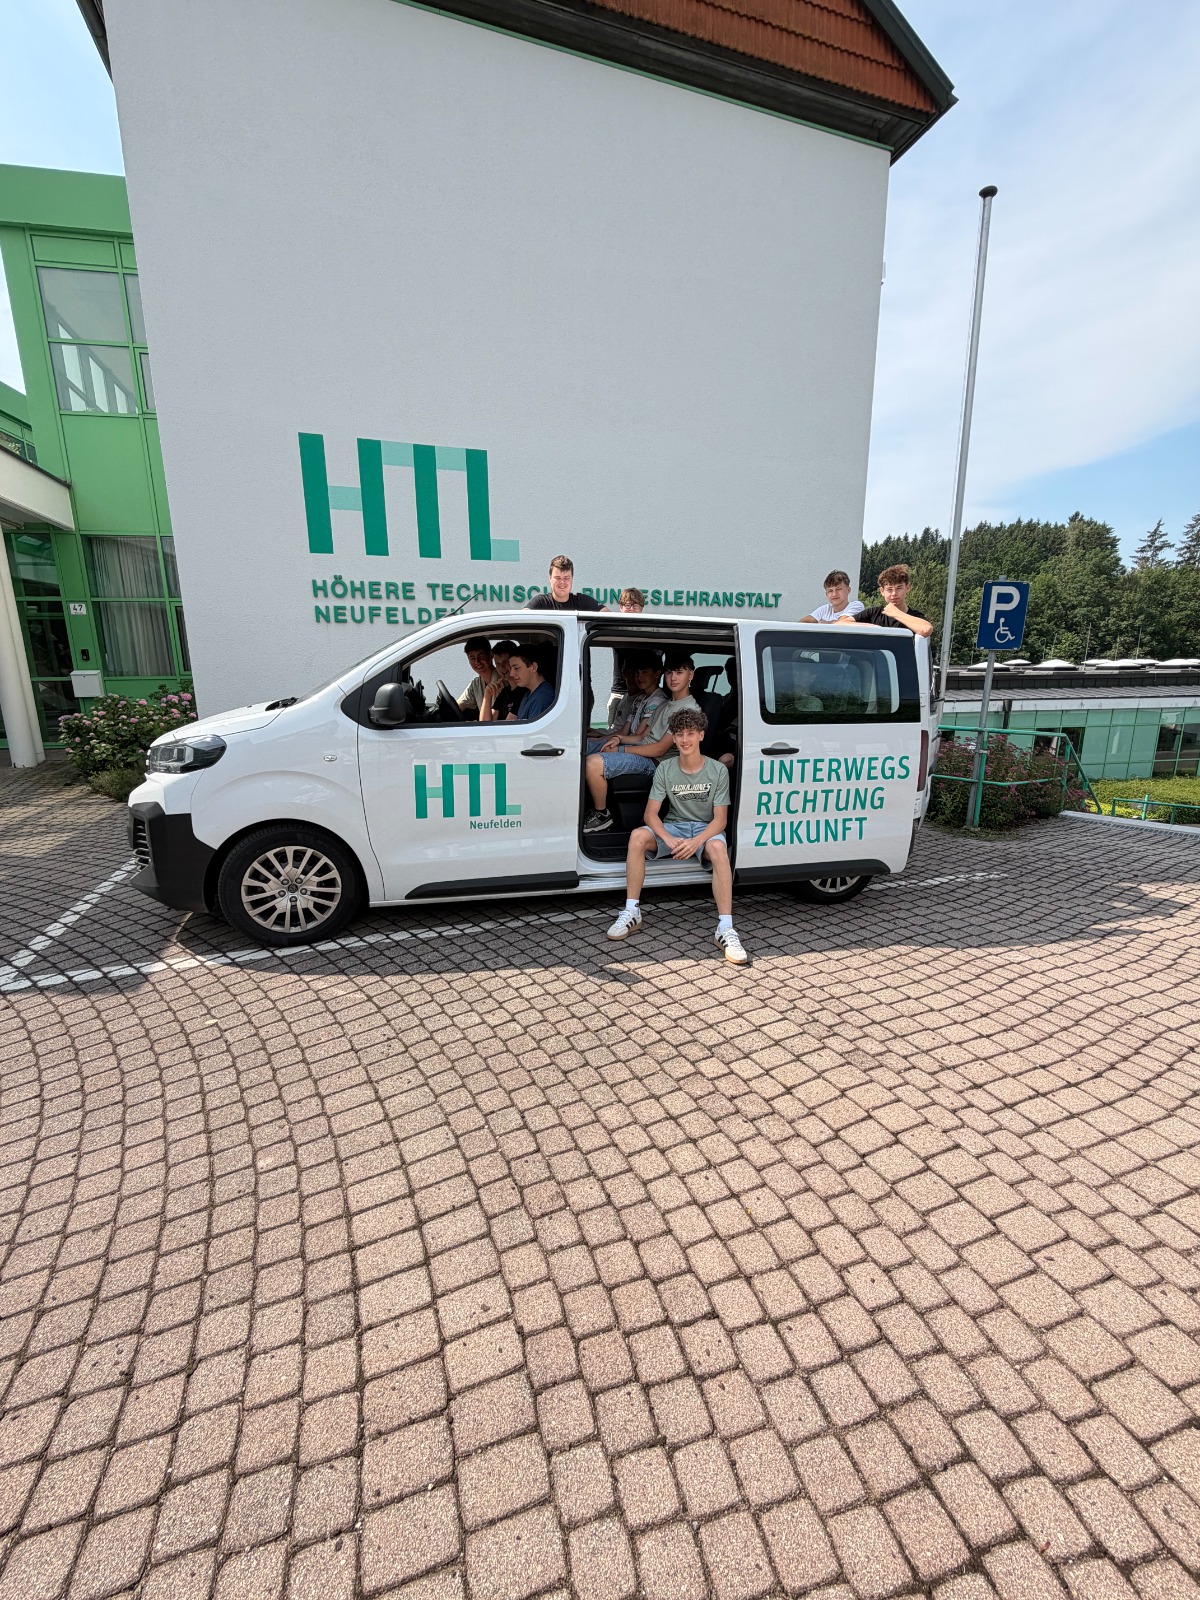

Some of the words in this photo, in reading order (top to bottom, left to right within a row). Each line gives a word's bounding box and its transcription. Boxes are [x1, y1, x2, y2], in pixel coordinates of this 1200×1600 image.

[298, 432, 520, 562] HTL
[312, 575, 416, 600] HÖHERE
[427, 583, 552, 603] TECHNISC
[582, 588, 782, 608] BUNESLEHRANSTALT
[987, 585, 1020, 624] P
[759, 755, 910, 785] UNTERWEGS
[414, 763, 521, 819] HTL
[756, 786, 885, 816] RICHTUNG
[469, 819, 522, 829] Neufelden
[754, 817, 867, 847] ZUKUNFT
